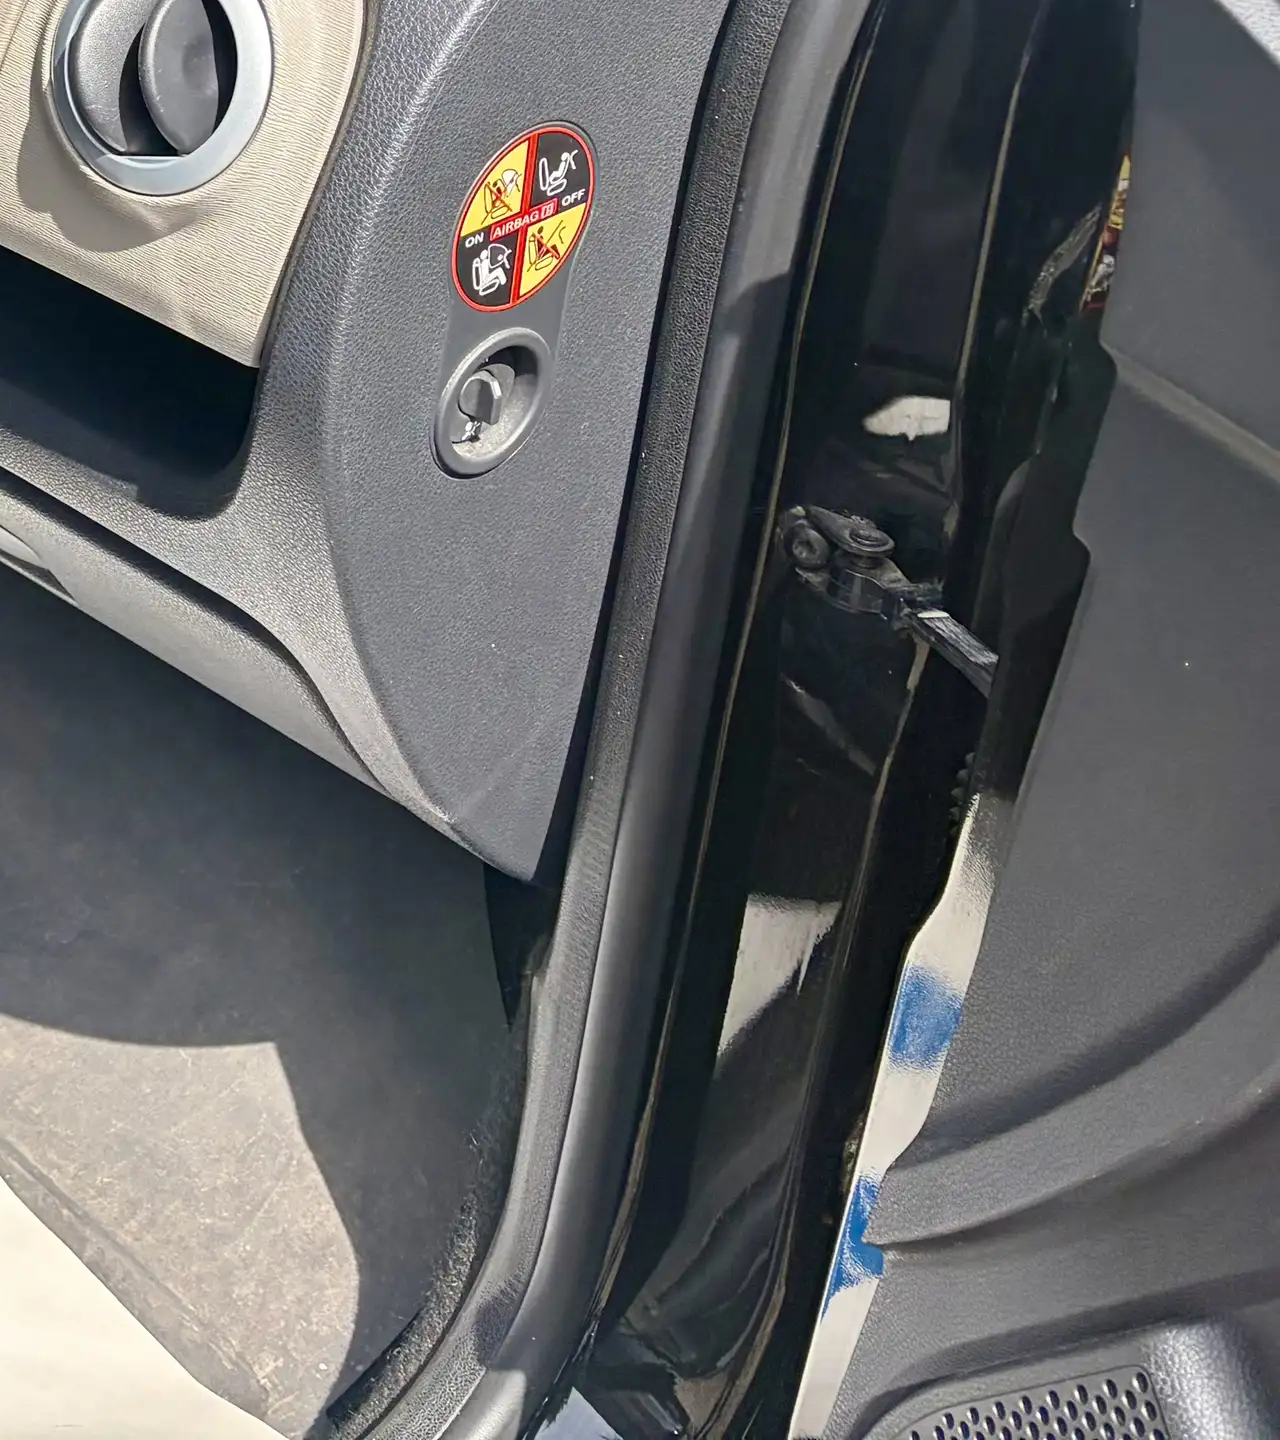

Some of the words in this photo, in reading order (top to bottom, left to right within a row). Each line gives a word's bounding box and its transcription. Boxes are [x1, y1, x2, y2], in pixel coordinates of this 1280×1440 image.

[465, 232, 485, 248] ON
[493, 211, 539, 239] AIRBAG
[561, 188, 586, 207] OFF
